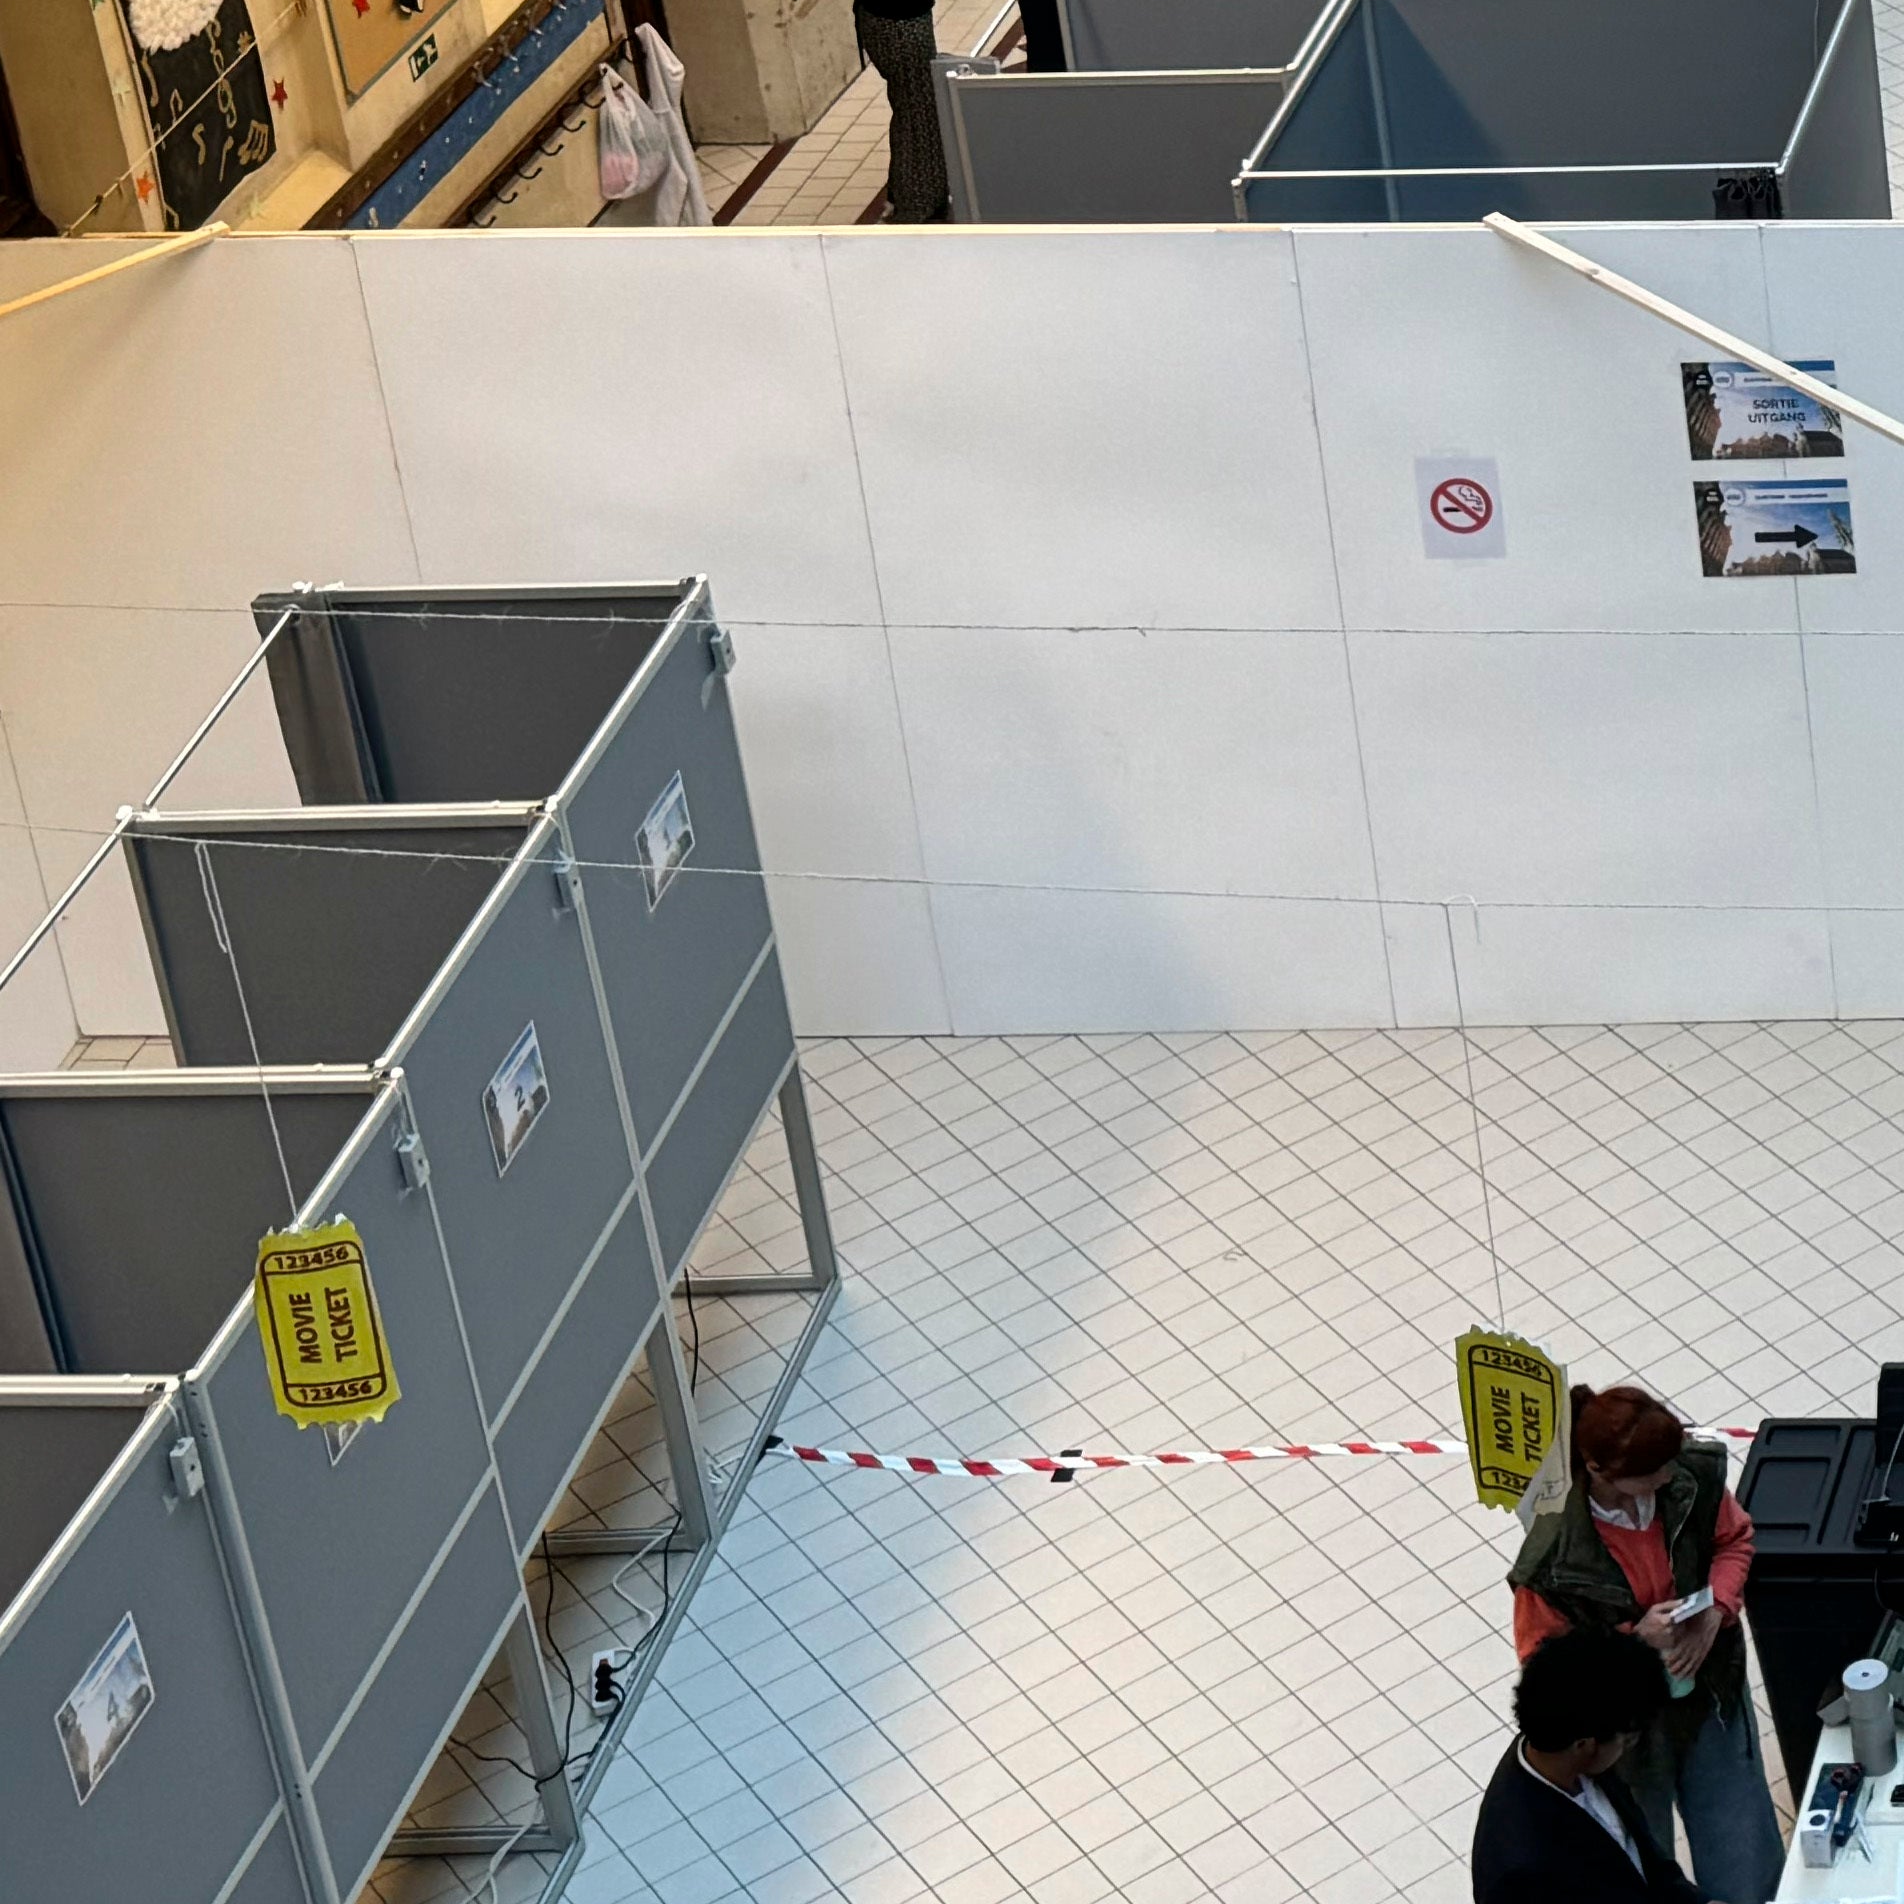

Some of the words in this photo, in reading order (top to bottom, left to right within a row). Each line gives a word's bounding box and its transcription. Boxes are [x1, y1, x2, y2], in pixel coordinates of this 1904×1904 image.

[1748, 412, 1806, 423] UITGANG
[1752, 398, 1799, 409] SORTIE
[274, 1247, 350, 1270] 123456
[289, 1291, 323, 1364] MOVIE
[325, 1287, 358, 1363] TICKET
[1491, 1385, 1515, 1454] MOVIE
[1520, 1391, 1543, 1463] TICKET
